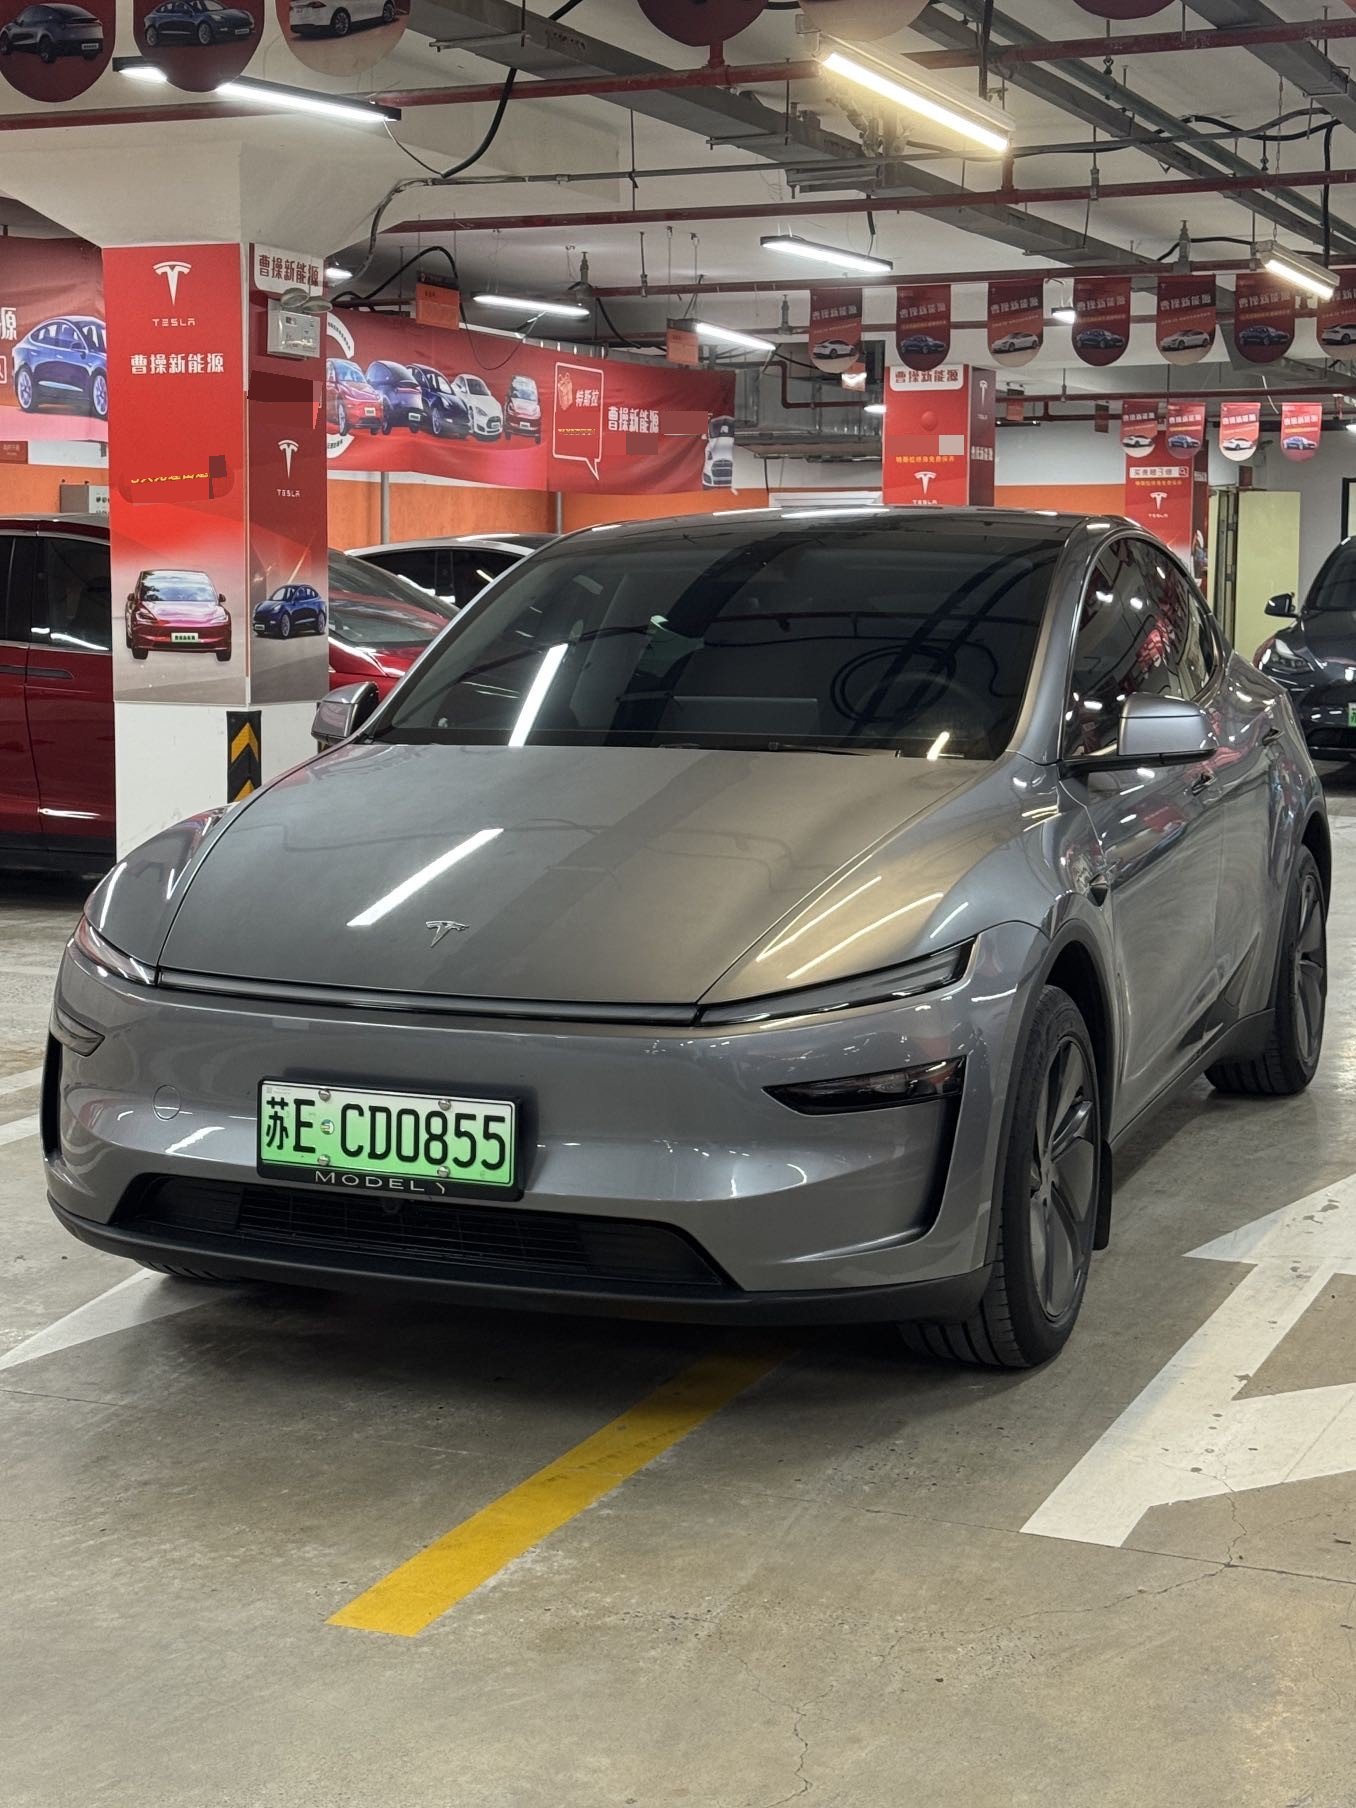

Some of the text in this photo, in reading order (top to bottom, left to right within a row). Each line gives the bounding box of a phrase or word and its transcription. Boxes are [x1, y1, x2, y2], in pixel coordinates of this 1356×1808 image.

[258, 254, 319, 287] 曹操新能源
[152, 318, 196, 327] TESLA
[130, 353, 225, 375] 曹操新能源
[575, 389, 600, 407] 特斯拉
[607, 405, 660, 434] 曹操新能源
[315, 1170, 425, 1192] MODEL
